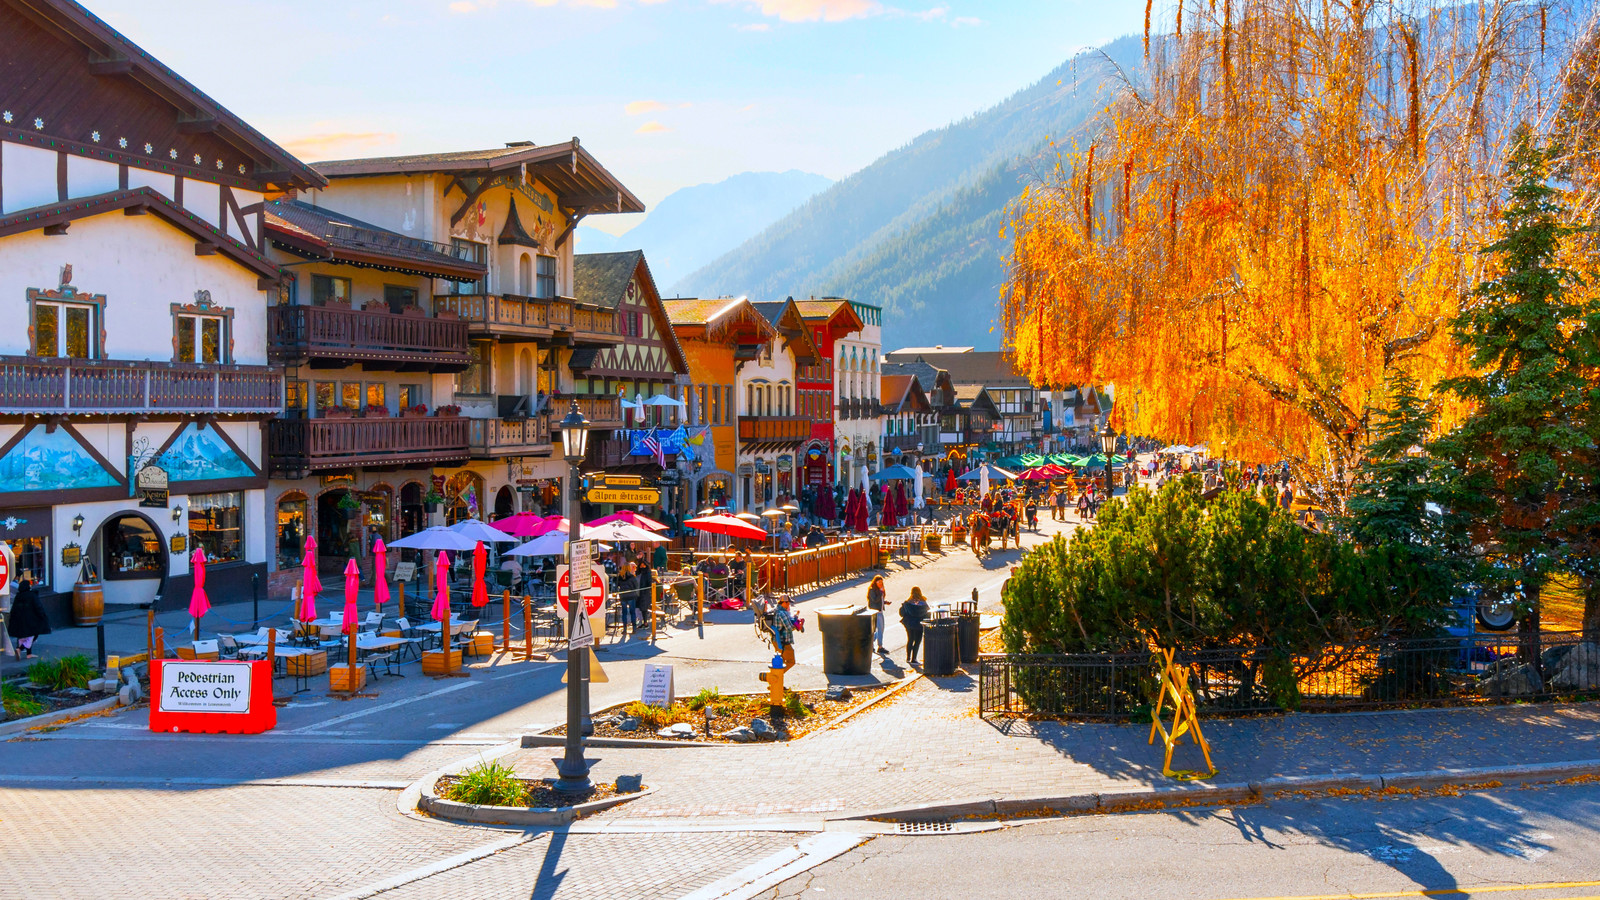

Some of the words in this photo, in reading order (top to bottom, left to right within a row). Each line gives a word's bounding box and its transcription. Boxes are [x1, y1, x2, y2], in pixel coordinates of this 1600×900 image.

[594, 491, 617, 501] Alpen
[620, 491, 652, 501] Strasse
[177, 671, 235, 684] Pedestrian
[170, 686, 208, 699] Access
[213, 687, 241, 702] Only
